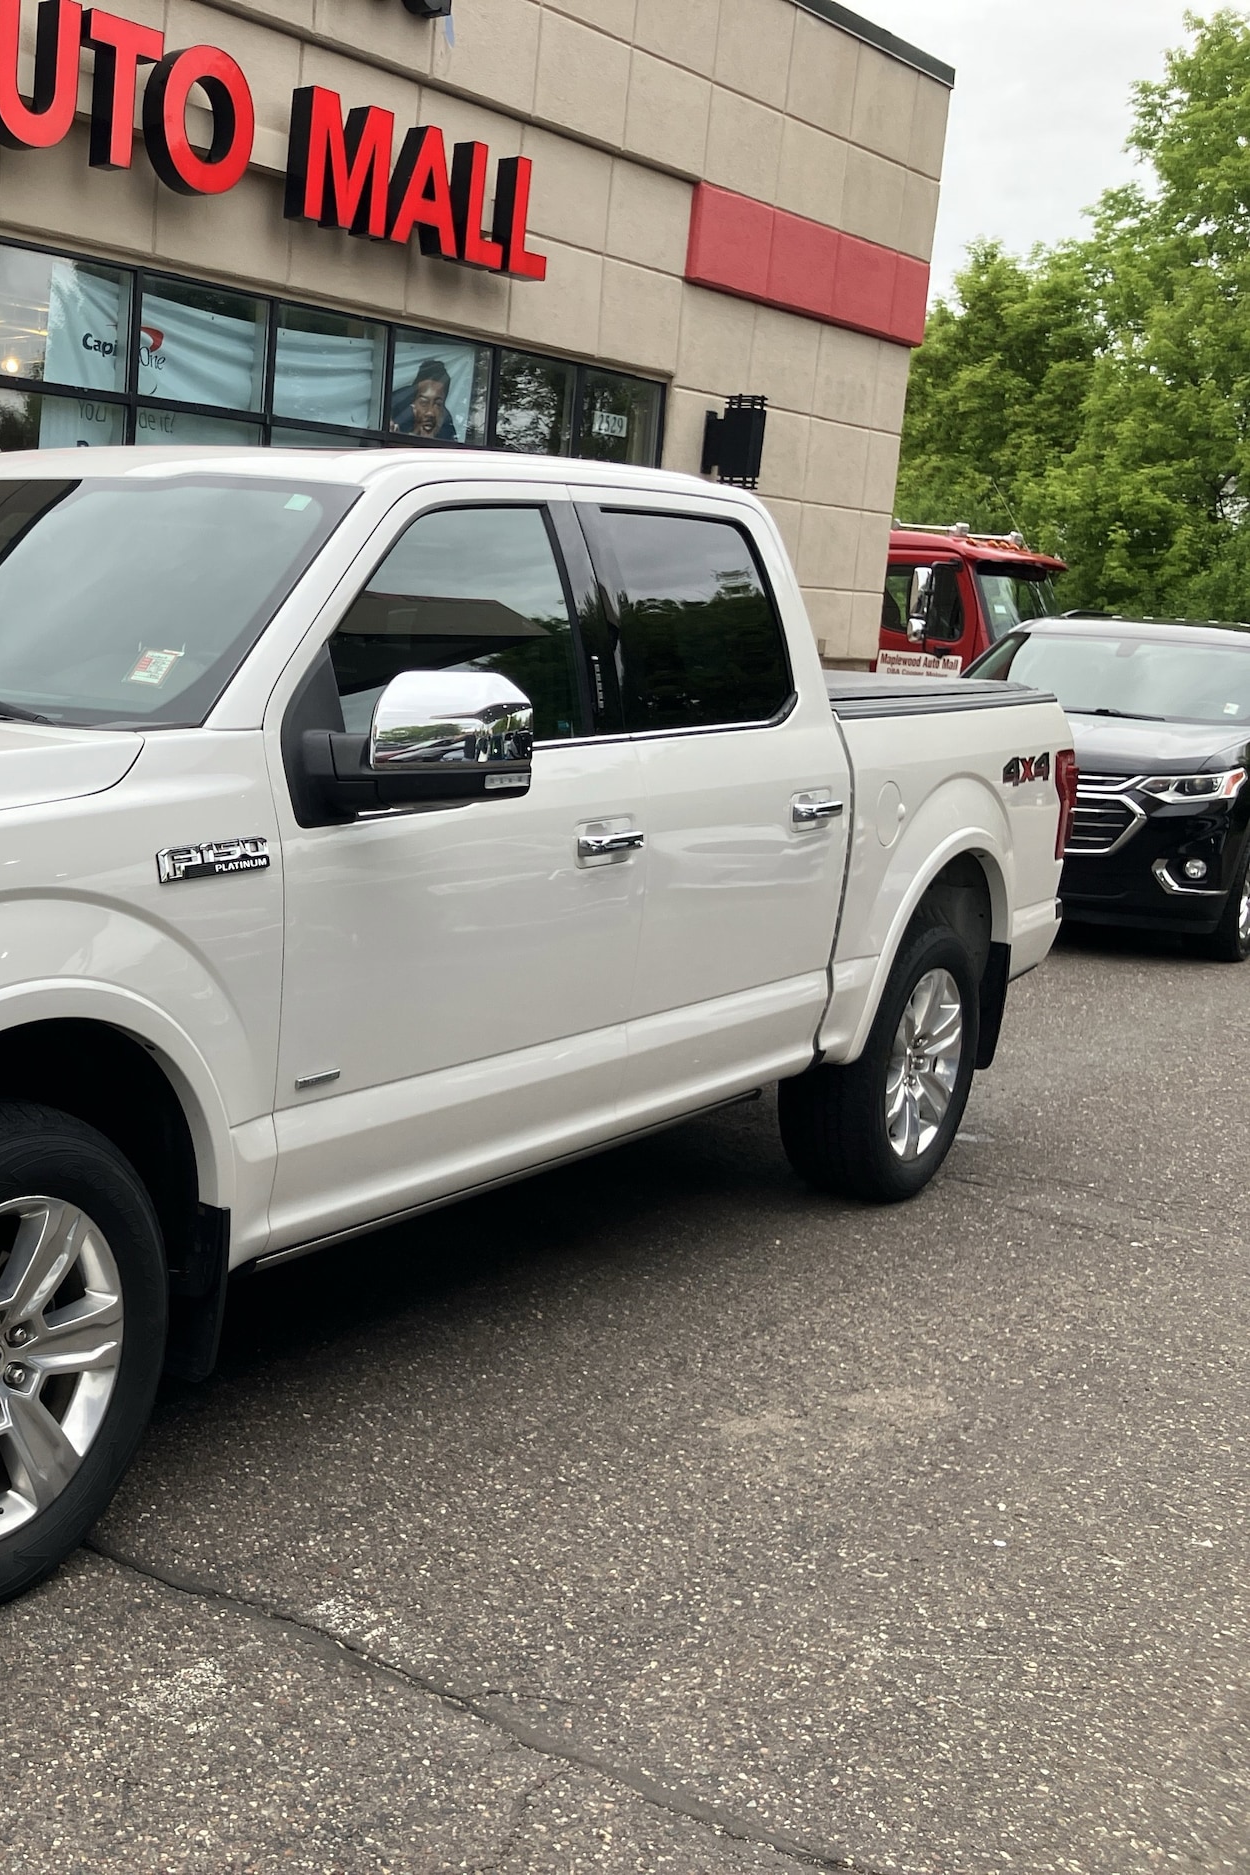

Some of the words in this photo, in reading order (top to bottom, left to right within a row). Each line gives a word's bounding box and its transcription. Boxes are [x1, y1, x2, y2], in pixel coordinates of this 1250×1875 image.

[287, 85, 547, 281] MALL
[82, 332, 118, 357] Capi
[598, 414, 624, 434] 2529
[880, 653, 921, 668] Maplewood
[923, 656, 940, 669] Auto
[942, 658, 959, 671] Mall
[215, 857, 268, 873] PLATINUM
